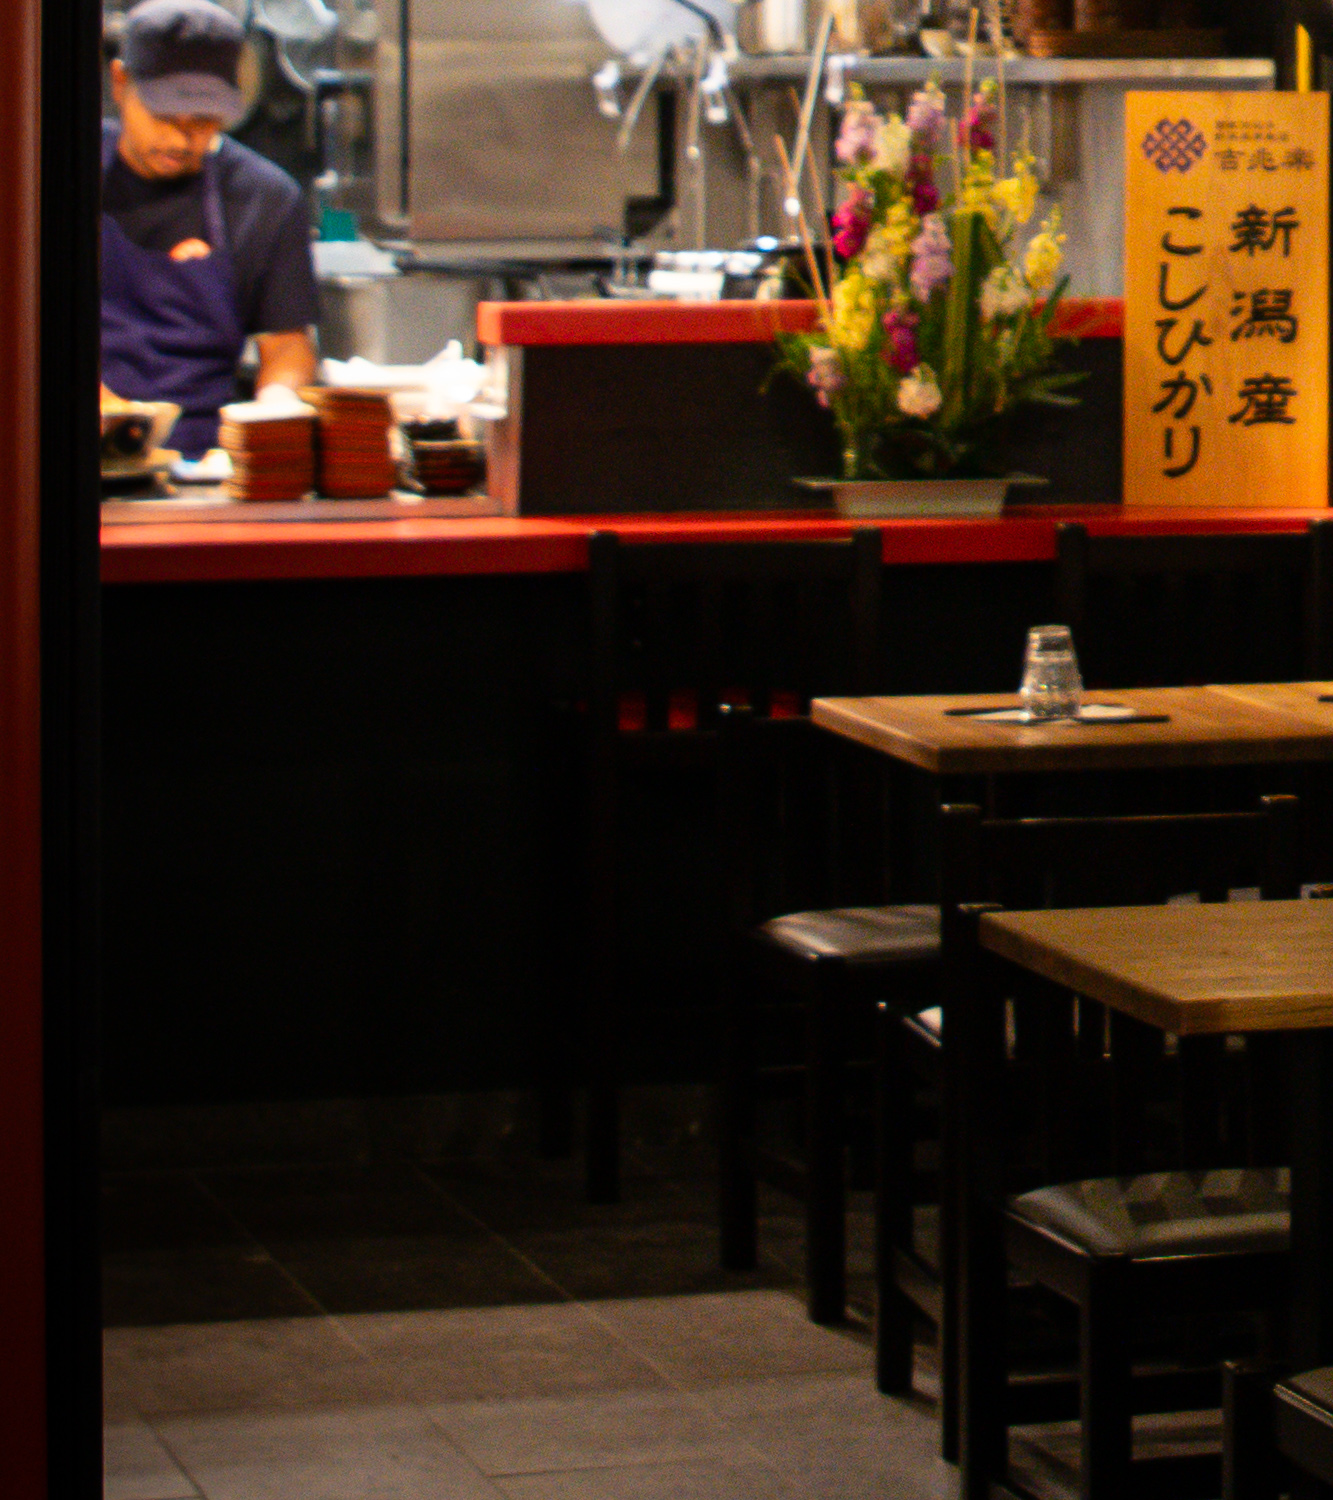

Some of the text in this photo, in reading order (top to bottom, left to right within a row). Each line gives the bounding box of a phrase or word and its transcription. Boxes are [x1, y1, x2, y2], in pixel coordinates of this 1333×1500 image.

[1152, 206, 1213, 478] こしひかり
[1229, 203, 1298, 427] 新潟産
